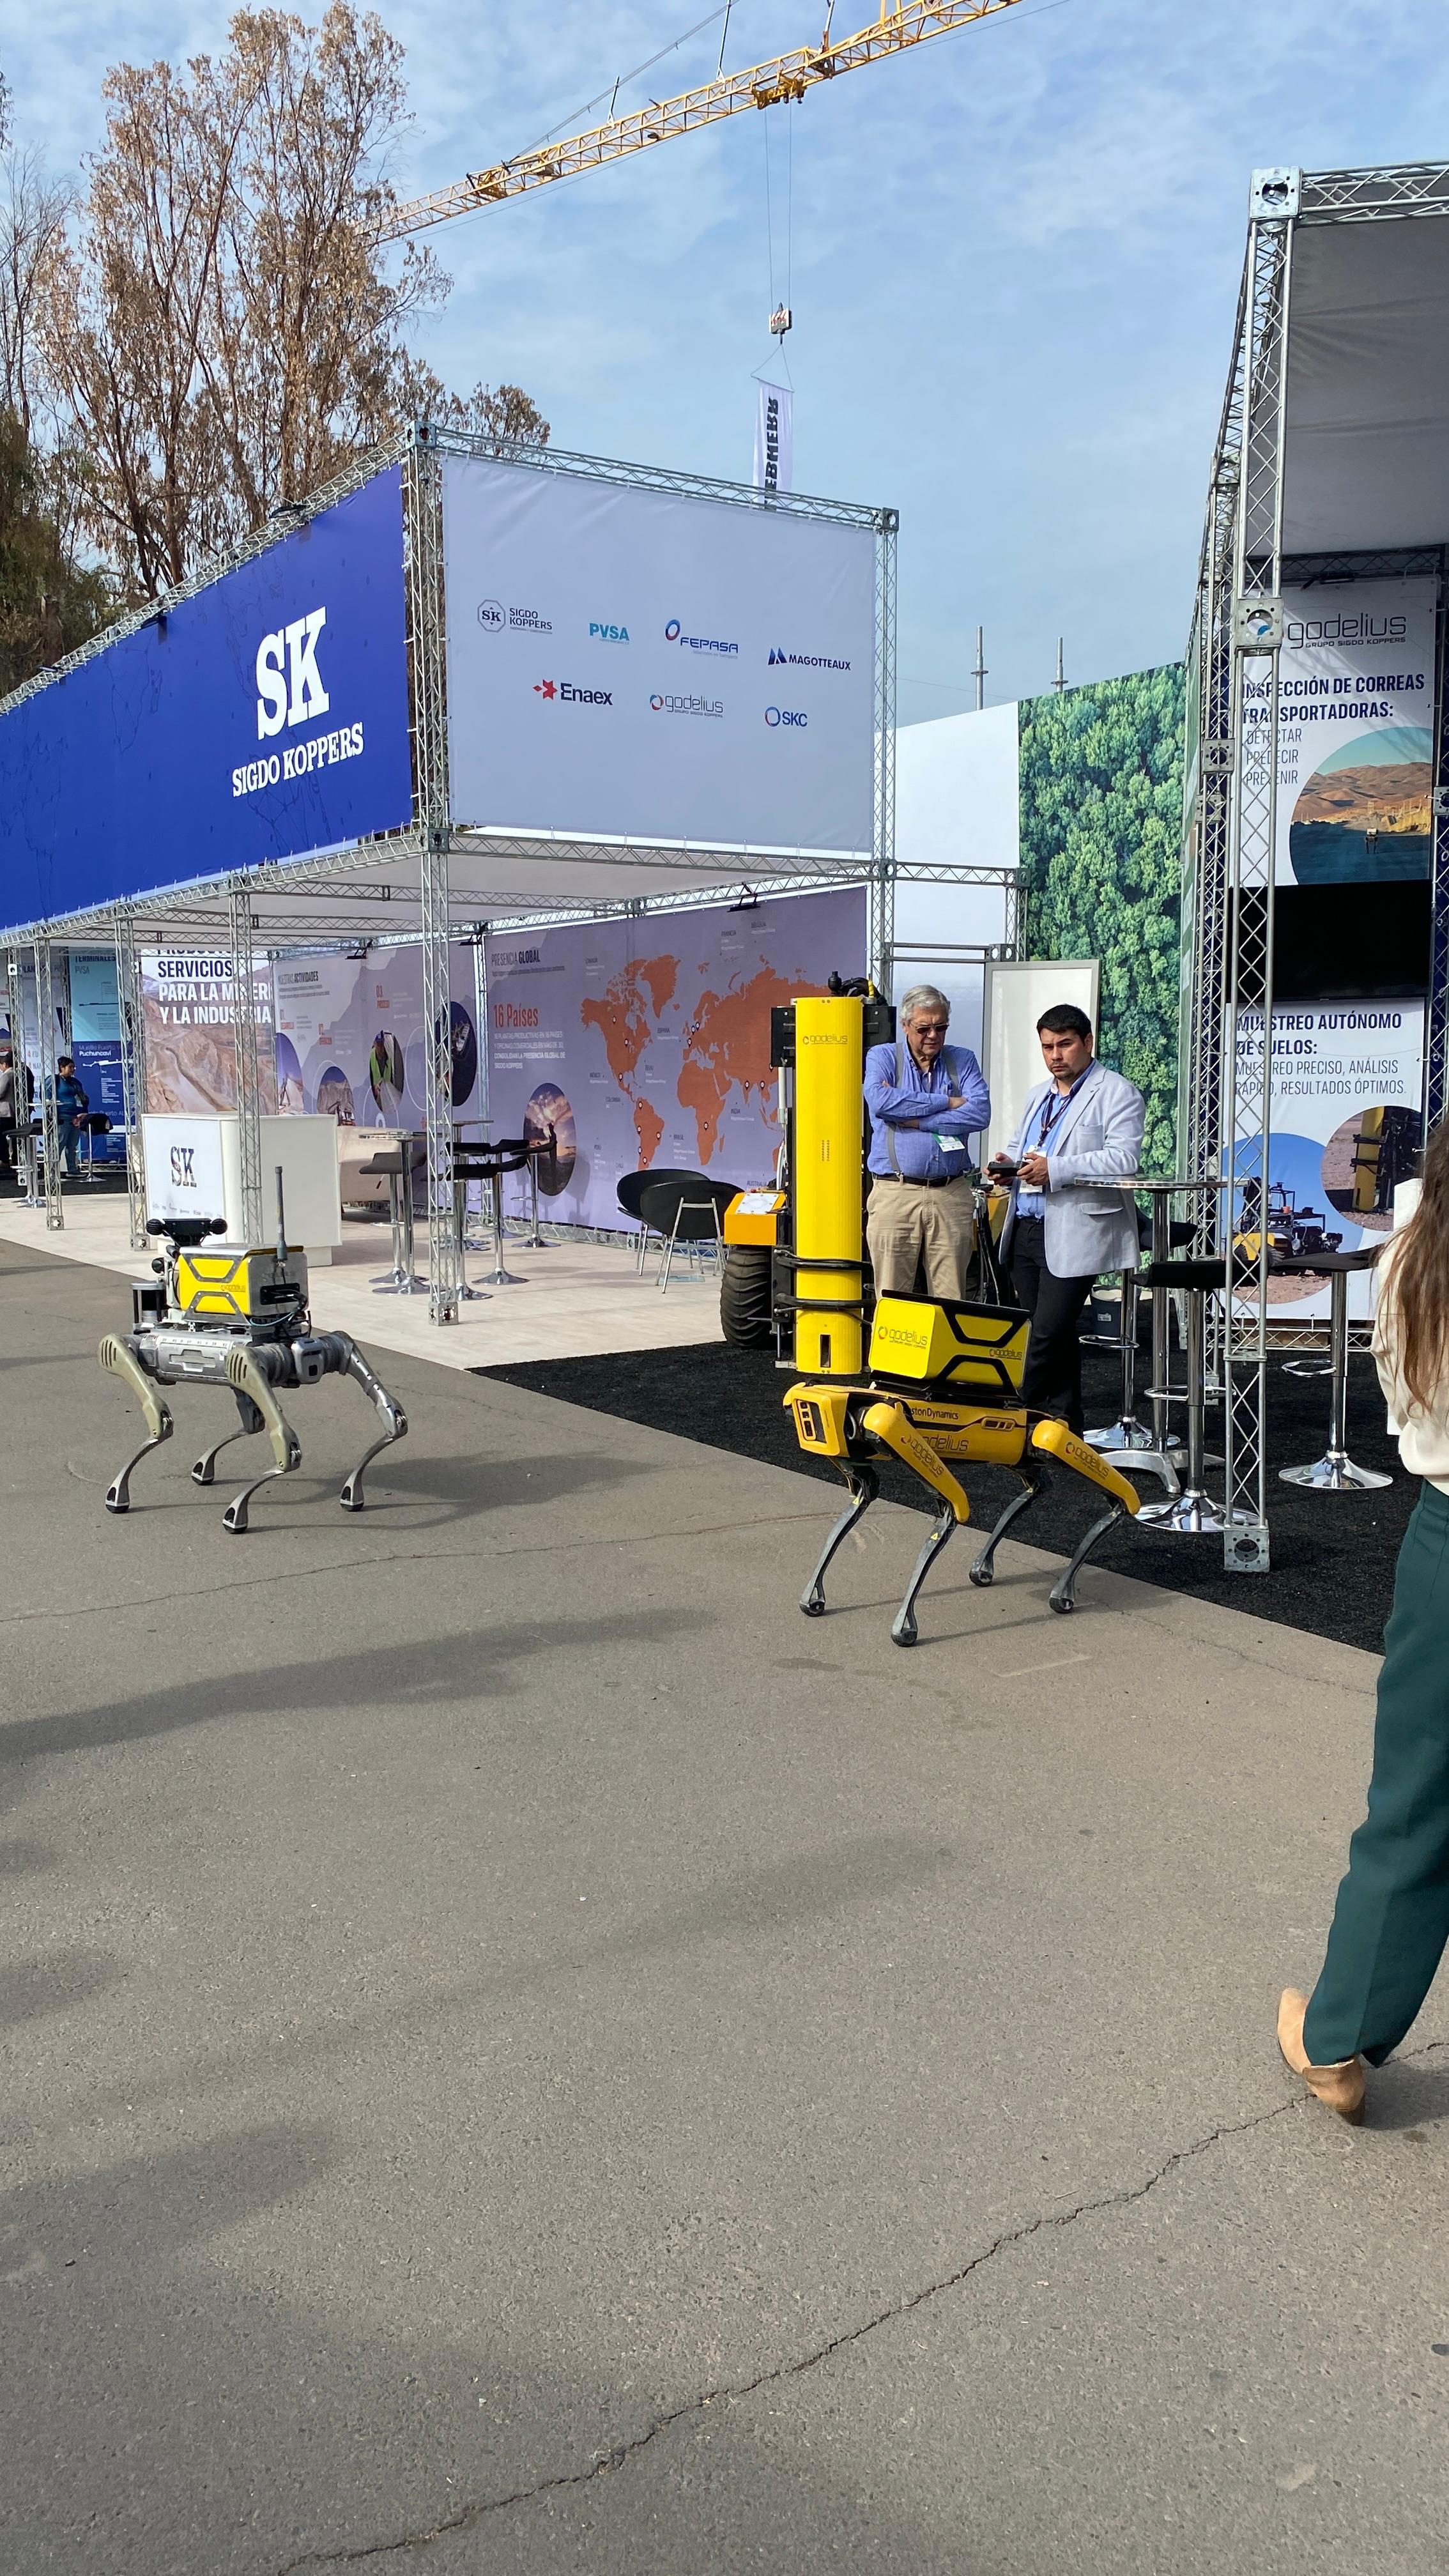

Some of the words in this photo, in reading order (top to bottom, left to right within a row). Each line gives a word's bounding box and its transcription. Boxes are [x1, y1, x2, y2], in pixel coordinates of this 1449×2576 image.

[482, 610, 502, 622] SK
[509, 608, 538, 619] SIGDO
[509, 617, 553, 630] KOPPERS
[589, 623, 630, 641] PVSA
[1287, 612, 1406, 649] godelius
[680, 637, 739, 654] FEPASA
[789, 654, 851, 671] MAGOTTEAUX
[256, 606, 330, 741] SK
[1333, 677, 1351, 694] DE
[1356, 673, 1425, 693] CORREAS
[560, 682, 613, 706] Enaex
[665, 694, 723, 713] godelius
[782, 711, 808, 727] SKC
[1243, 702, 1394, 724] TRASPORTADORAS:
[232, 754, 280, 798] SIGDO
[282, 721, 364, 781] KOPPERS
[1246, 770, 1298, 786] PREENIR
[491, 952, 518, 967] PRESENCIA
[518, 949, 540, 964] GLOBAL
[157, 960, 233, 978] SERVICIOS
[160, 983, 198, 1002] PARA
[201, 982, 218, 1001] LA
[159, 1006, 169, 1025] Y
[172, 1006, 191, 1025] LA
[493, 1004, 504, 1028] 16
[507, 1002, 539, 1028] Países
[1318, 1010, 1402, 1030] AUTÓNOMO
[809, 1034, 848, 1045] godelius
[1236, 1040, 1254, 1055] DE
[1296, 1059, 1346, 1077] PRECISO,
[1349, 1057, 1399, 1075] ANÁLISIS
[1280, 1080, 1351, 1095] RESULTADOS
[1354, 1077, 1407, 1094] ÓPTIMOS.
[171, 1146, 197, 1188] SK
[889, 1329, 928, 1346] godelius
